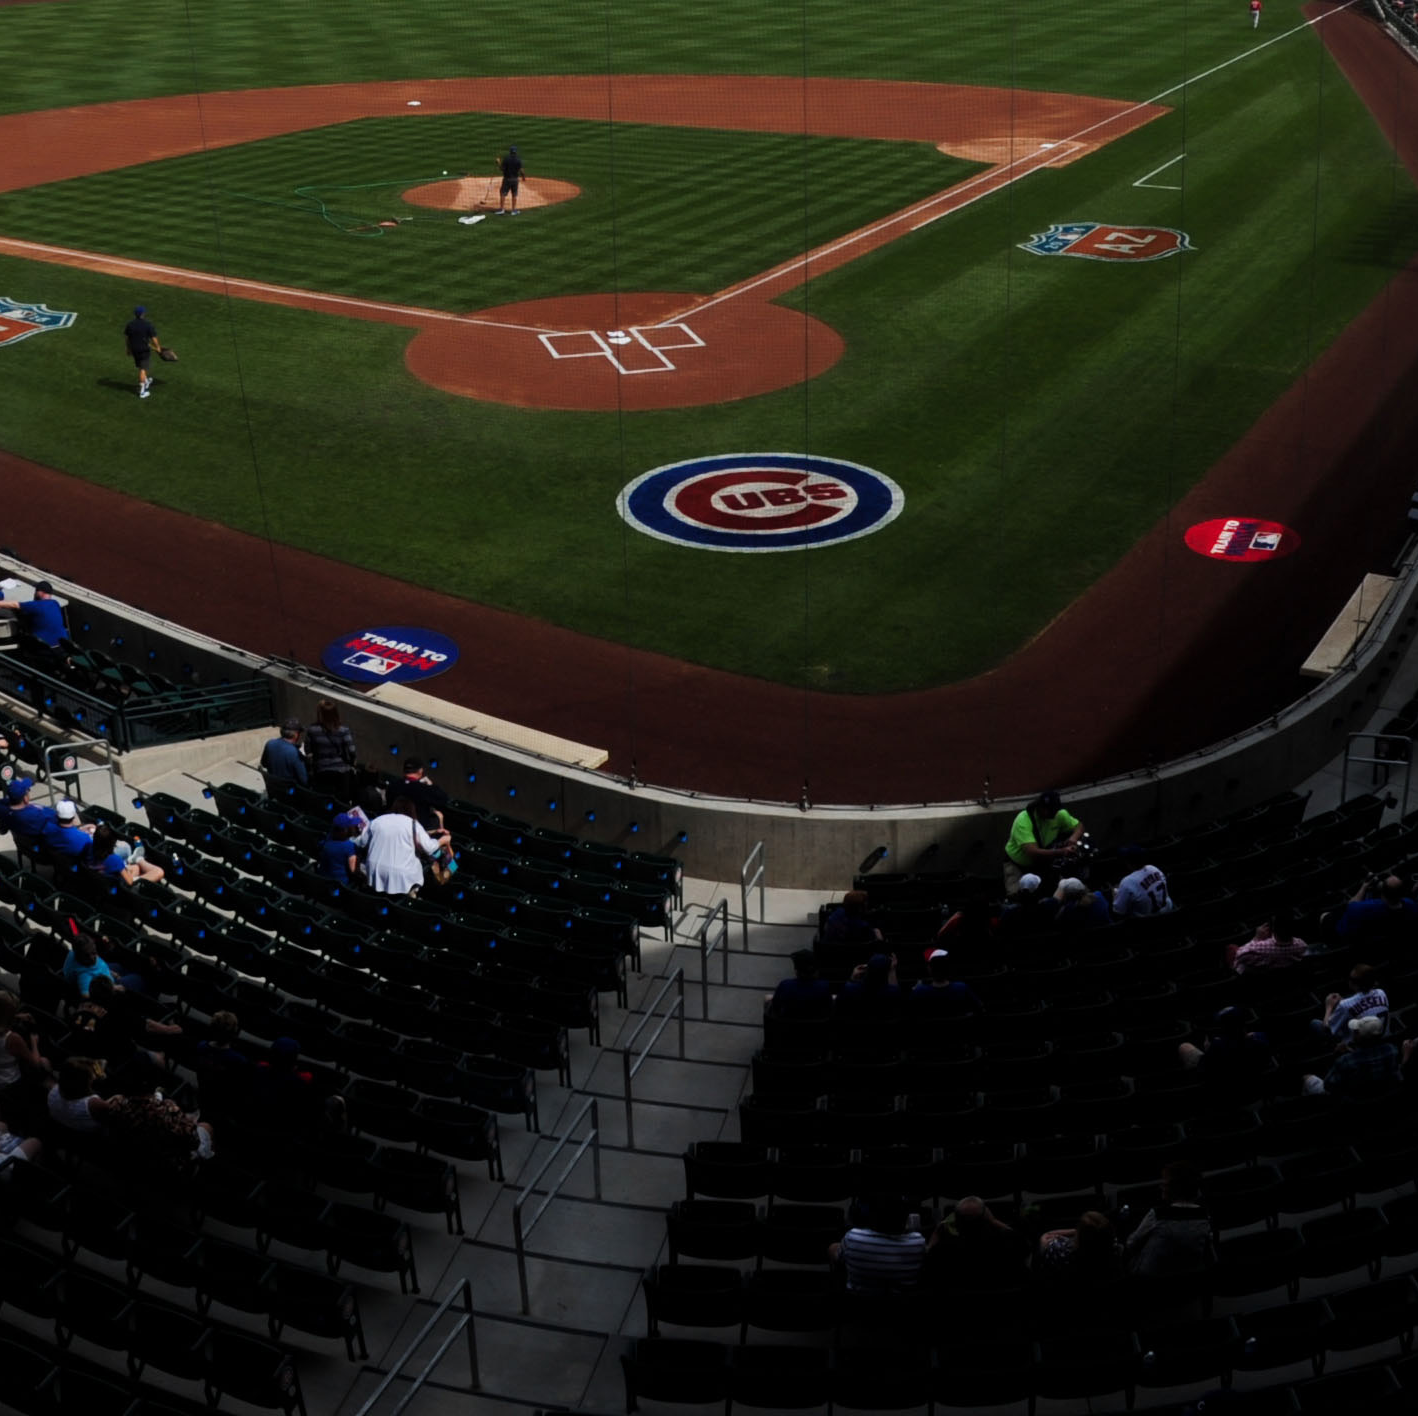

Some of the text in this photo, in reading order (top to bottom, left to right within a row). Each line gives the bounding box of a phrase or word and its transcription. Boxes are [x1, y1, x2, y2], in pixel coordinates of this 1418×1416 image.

[675, 470, 849, 531] CUBS
[360, 632, 448, 662] TRAIN TO
[1148, 881, 1167, 912] 17
[1348, 994, 1388, 1018] RUSSELL
